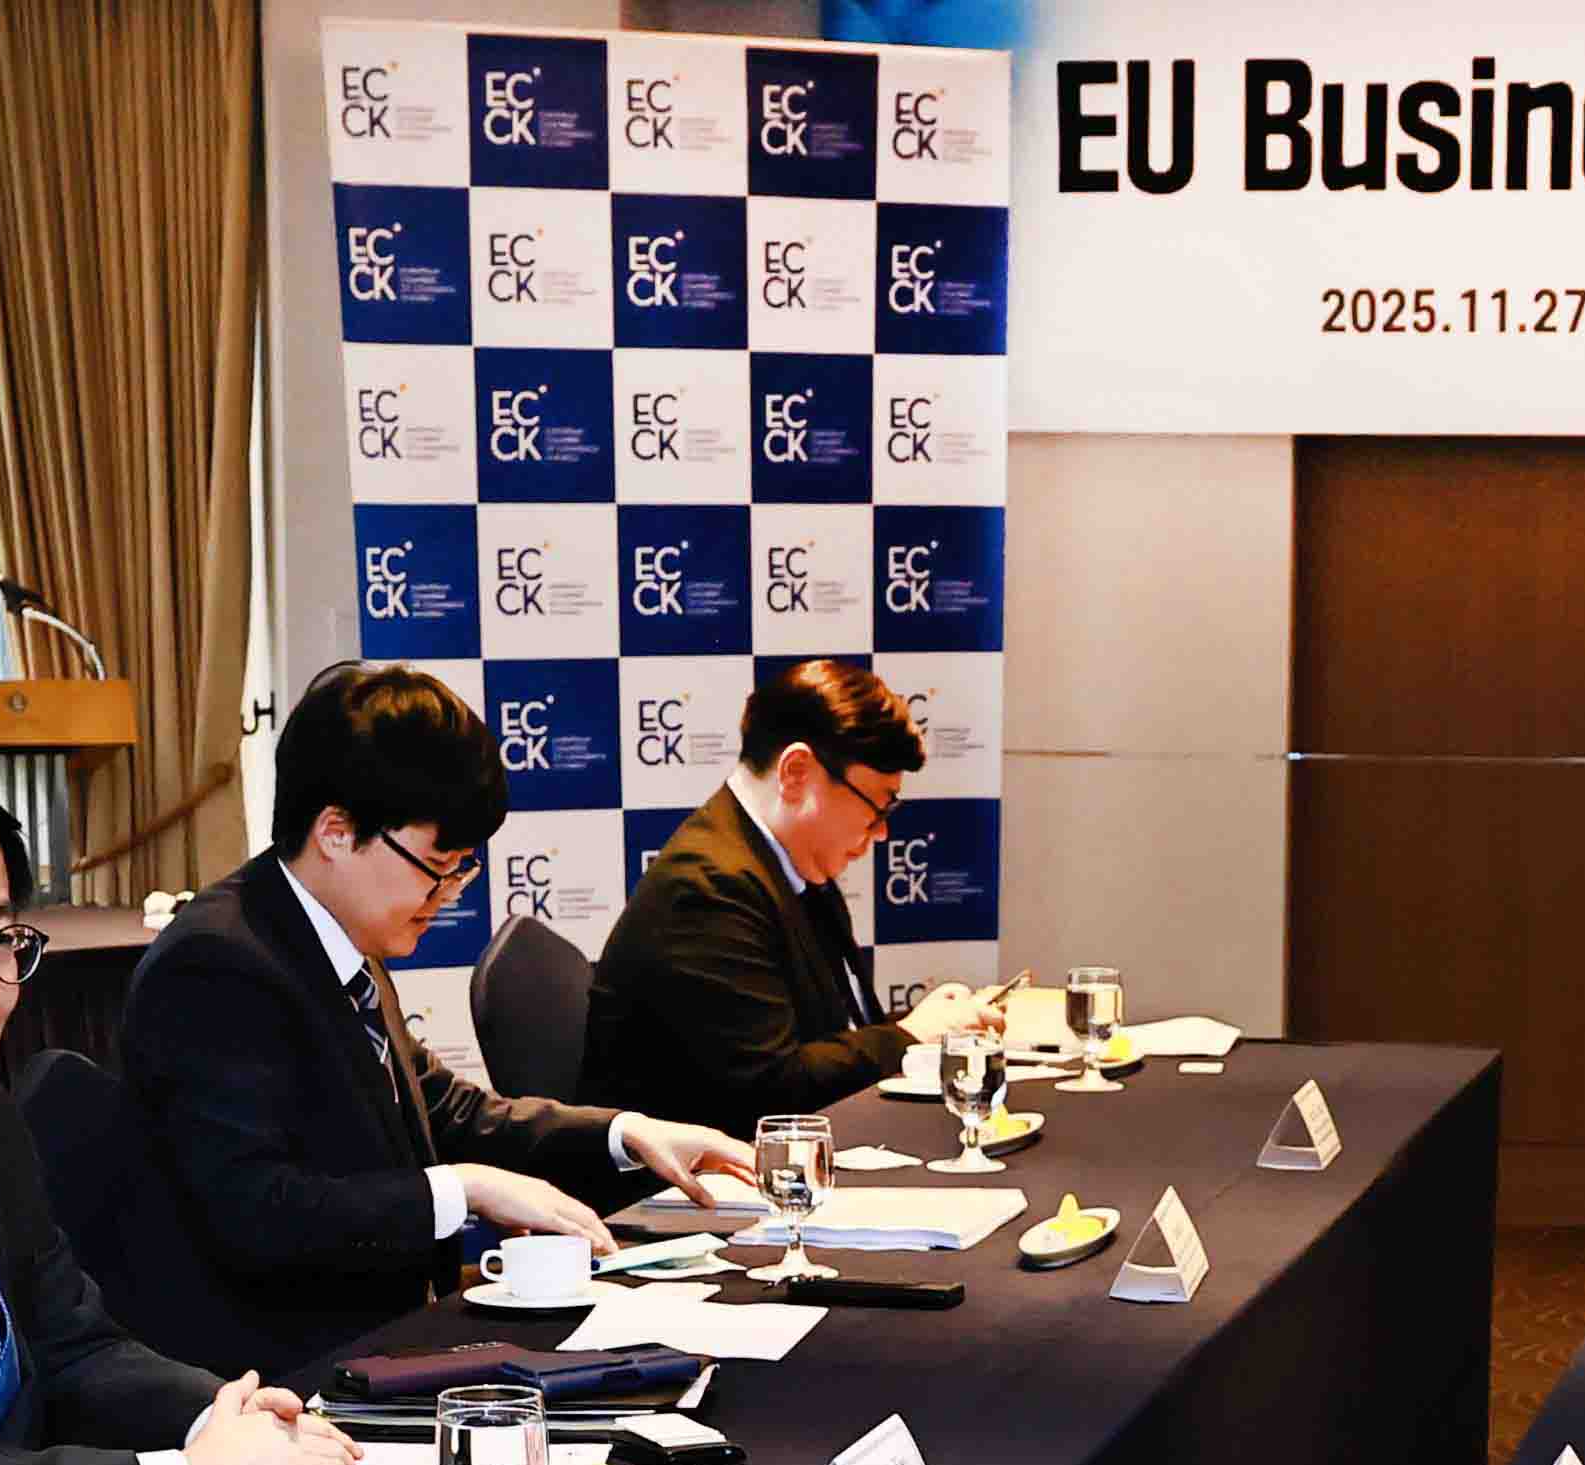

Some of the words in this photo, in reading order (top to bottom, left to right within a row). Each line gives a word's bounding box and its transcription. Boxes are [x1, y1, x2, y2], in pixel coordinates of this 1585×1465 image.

[342, 66, 388, 101] EC
[485, 71, 534, 110] EC
[627, 79, 672, 113] EC
[763, 84, 806, 120] EC
[895, 92, 937, 124] EC
[341, 105, 392, 138] CK
[483, 111, 536, 146] CK
[625, 116, 674, 149] CK
[1056, 58, 1194, 194] EU
[760, 121, 807, 156] CK
[892, 128, 939, 160] CK
[349, 227, 395, 265] EC
[490, 234, 535, 267] EC
[628, 236, 676, 271] EC
[765, 242, 805, 274] EC
[892, 246, 935, 279] EC
[348, 265, 397, 301] CK
[488, 270, 537, 303] CK
[627, 271, 678, 306] CK
[763, 277, 806, 308] CK
[888, 279, 935, 313] CK
[359, 390, 398, 422] EC
[492, 391, 541, 428] EC
[633, 393, 677, 426] EC
[765, 393, 806, 427] EC
[890, 398, 930, 429] EC
[358, 428, 402, 459] CK
[490, 428, 542, 463] CK
[631, 429, 680, 462] CK
[763, 428, 808, 463] CK
[887, 431, 931, 463] CK
[367, 546, 405, 582] EC
[498, 548, 541, 580] EC
[635, 546, 682, 581] EC
[769, 547, 807, 579] EC
[888, 545, 930, 579] EC
[366, 583, 408, 619] CK
[496, 583, 544, 616] CK
[633, 582, 684, 616] CK
[767, 581, 809, 612] CK
[886, 579, 930, 612] CK
[502, 701, 546, 738] EC
[639, 701, 682, 733] EC
[500, 737, 550, 771] CK
[637, 734, 685, 766] CK
[888, 839, 927, 870] EC
[508, 855, 550, 888] EC
[887, 871, 928, 904] CK
